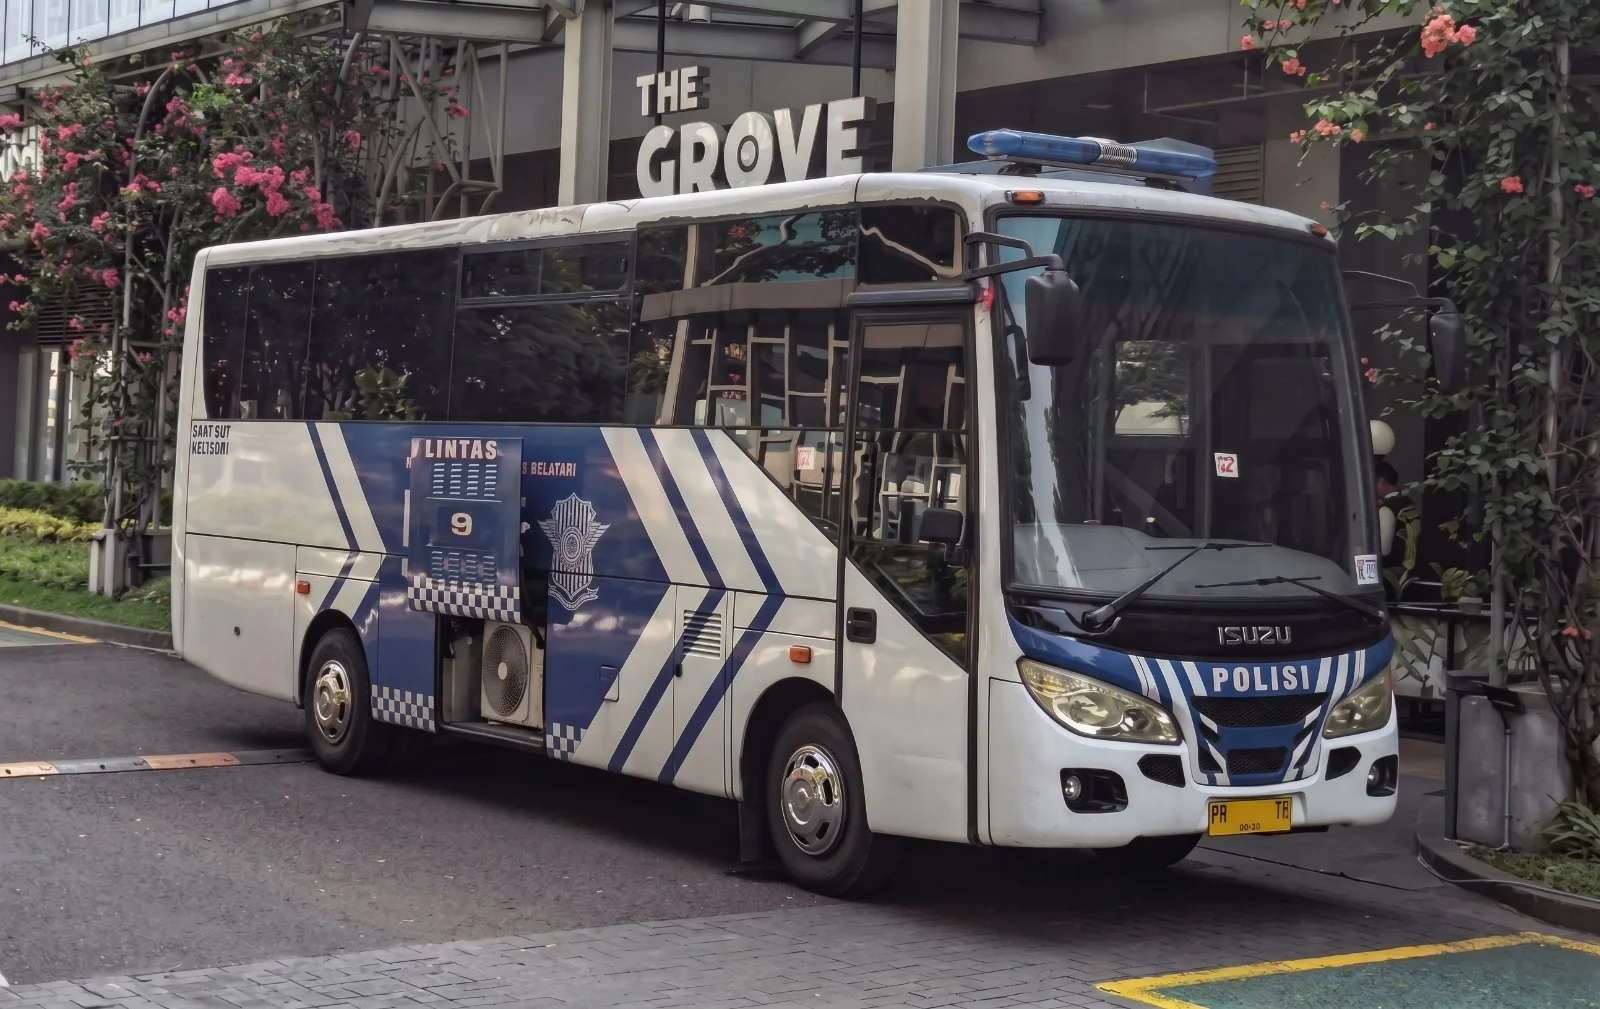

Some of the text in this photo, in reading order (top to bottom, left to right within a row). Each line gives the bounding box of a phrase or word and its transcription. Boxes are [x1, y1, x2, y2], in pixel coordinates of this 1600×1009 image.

[636, 65, 708, 117] THE
[636, 96, 874, 199] GROVE
[425, 439, 498, 460] LINTAS
[530, 462, 577, 477] BELATARI
[451, 512, 473, 536] 9
[1217, 626, 1292, 645] ISUZU
[1212, 665, 1309, 692] POLISI
